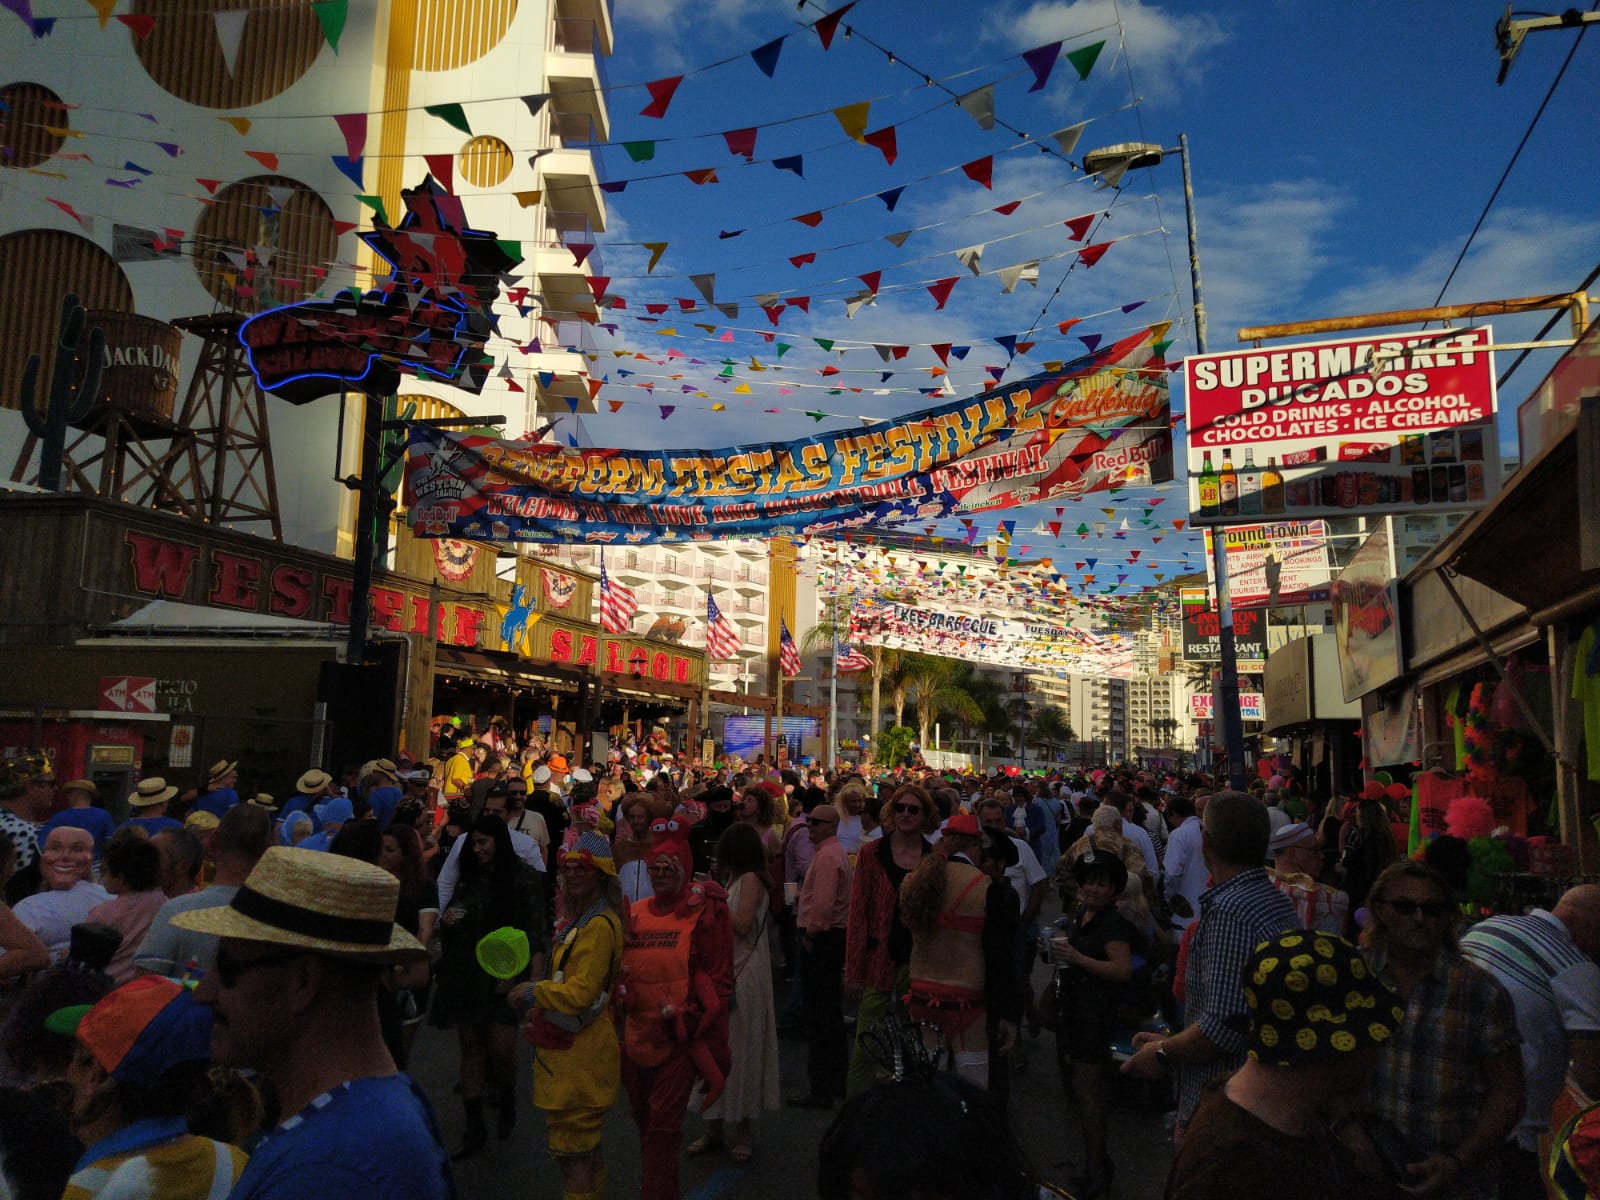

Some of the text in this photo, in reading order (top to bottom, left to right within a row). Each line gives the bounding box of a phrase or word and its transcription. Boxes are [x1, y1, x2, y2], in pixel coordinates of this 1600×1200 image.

[103, 344, 149, 369] JACK
[1194, 334, 1479, 391] SUPERMARKET
[1242, 373, 1429, 409] DUCADOS
[1048, 384, 1164, 428] California
[1212, 394, 1471, 428] COLD DRINKS ALCOHOL
[1203, 407, 1483, 443] CHOCOLATES ICE CREAMS
[669, 443, 832, 497] FIESTAS
[835, 388, 1045, 486] FESTIVAL
[1093, 439, 1163, 472] Red Bull
[416, 478, 465, 499] WESTERN
[486, 493, 579, 522] WELCOME
[580, 502, 608, 523] TO
[650, 503, 708, 526] LOVE
[712, 502, 760, 524] AND
[929, 444, 1049, 494] FESTIVAL
[960, 498, 1002, 511] Heineken
[1226, 524, 1309, 543] ound Town
[126, 529, 486, 648] WESTERN
[929, 613, 998, 635] BARBECUE
[1190, 611, 1258, 625] CINNON
[1198, 623, 1251, 636] LOGE
[1025, 625, 1071, 637] TUESDAY
[551, 629, 690, 683] SALOON
[1188, 643, 1262, 654] RESTARANT
[108, 689, 126, 698] ATM
[136, 689, 154, 699] ATM
[1192, 696, 1260, 708] EXCNGE
